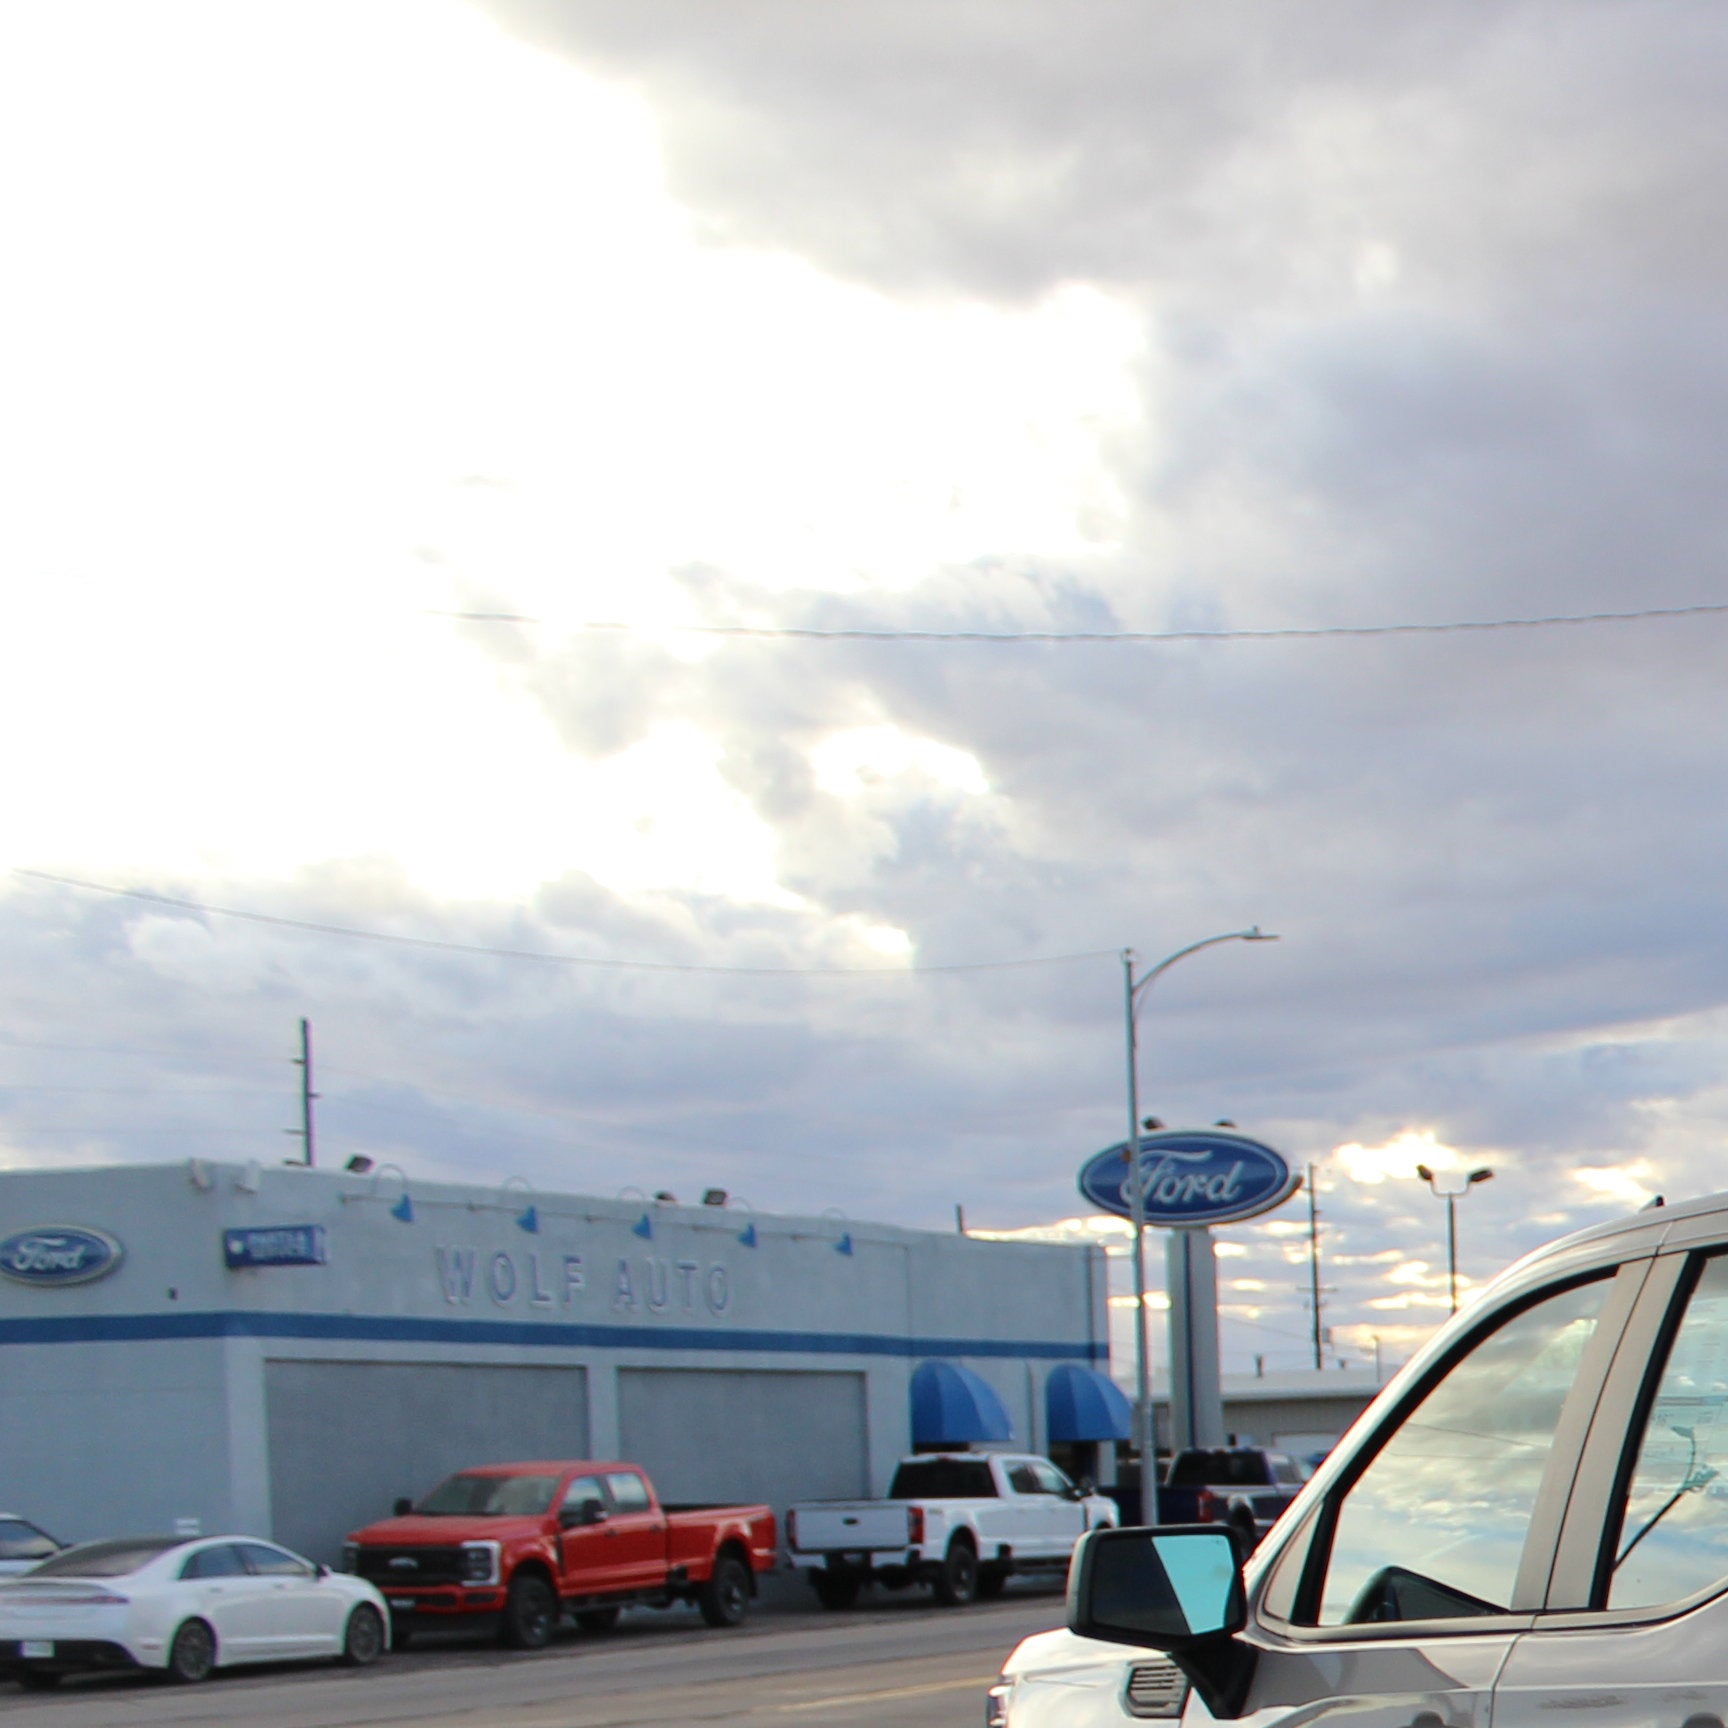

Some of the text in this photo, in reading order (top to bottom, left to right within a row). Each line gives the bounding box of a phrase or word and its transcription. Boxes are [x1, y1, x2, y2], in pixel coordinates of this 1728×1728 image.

[1120, 1148, 1245, 1205] Ford
[11, 1236, 86, 1271] Ford
[434, 1246, 731, 1316] WOLF AUTO
